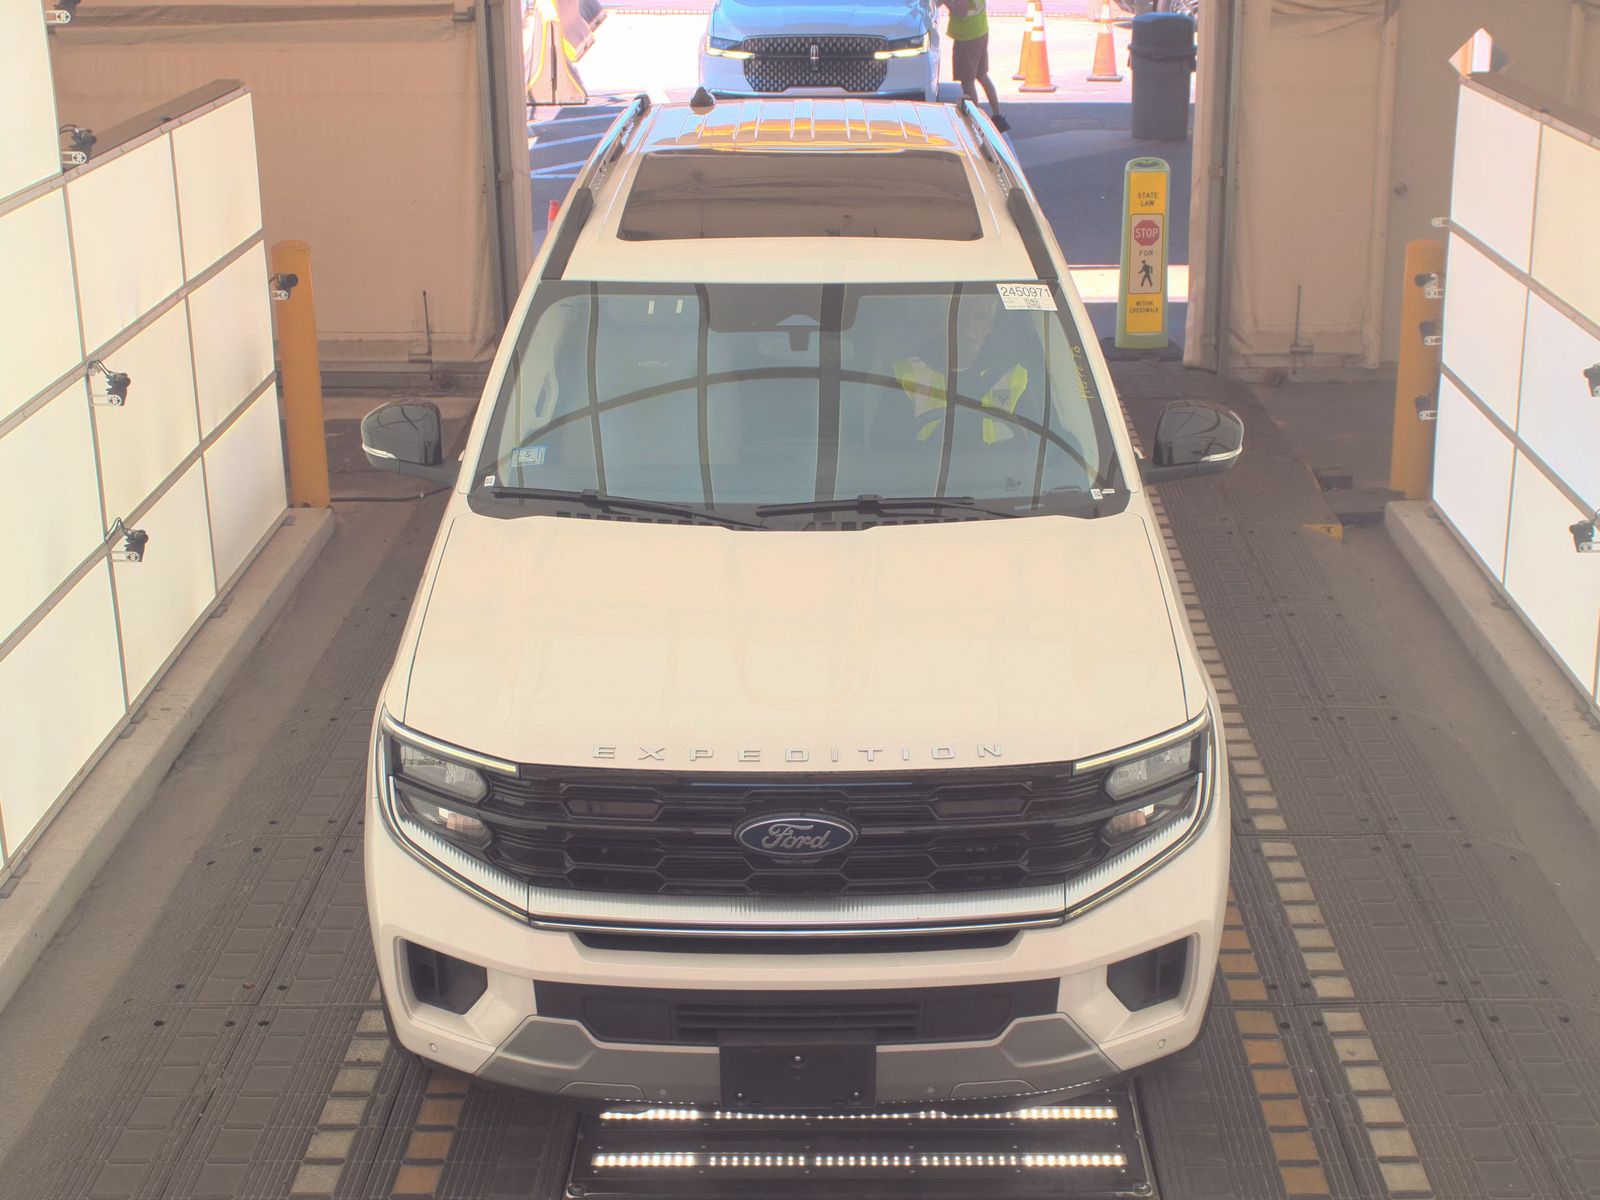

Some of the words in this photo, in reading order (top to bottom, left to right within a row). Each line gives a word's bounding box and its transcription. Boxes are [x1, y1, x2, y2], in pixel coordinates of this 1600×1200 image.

[1137, 191, 1158, 199] STATE
[1135, 227, 1159, 239] STOP
[1138, 249, 1153, 257] FOR
[1000, 286, 1051, 298] 2450971
[592, 743, 1003, 762] EXPEDITION
[761, 822, 830, 850] Ford
